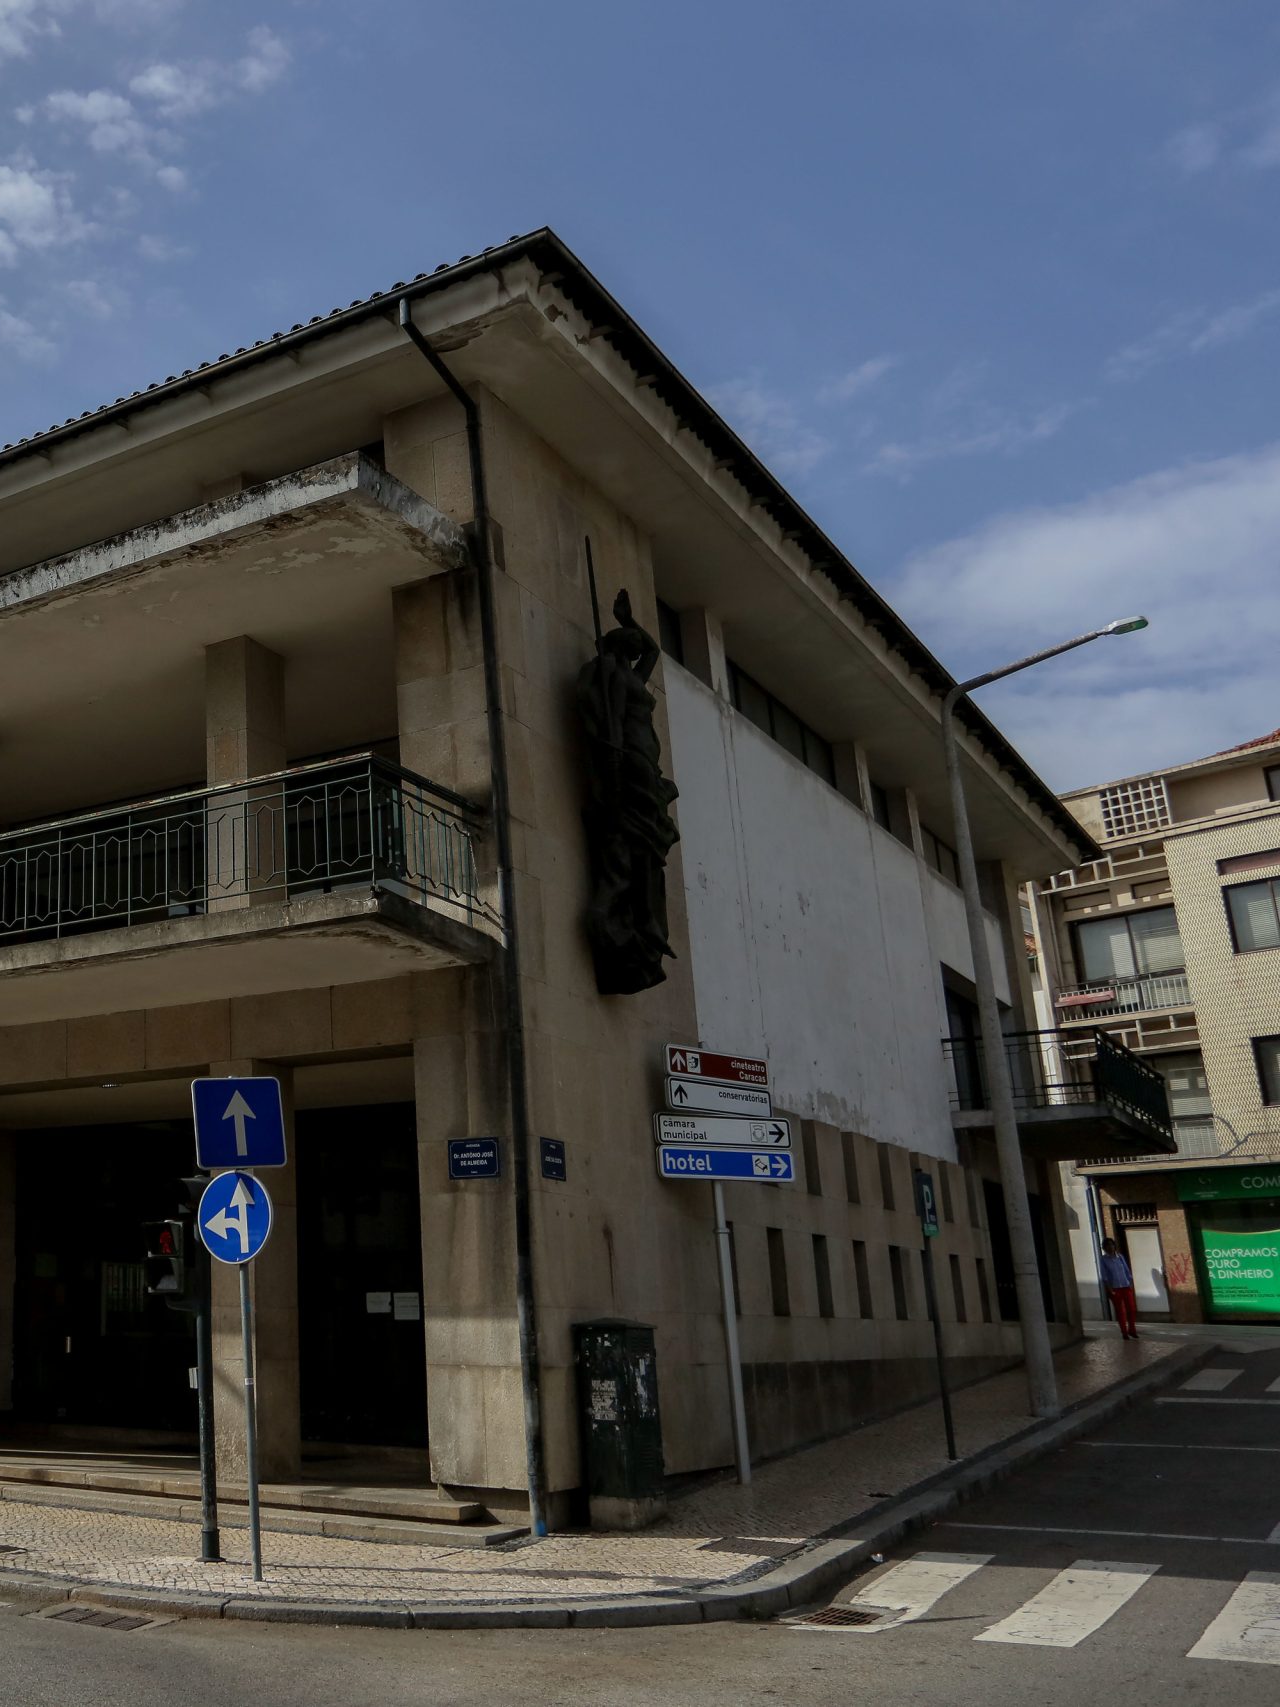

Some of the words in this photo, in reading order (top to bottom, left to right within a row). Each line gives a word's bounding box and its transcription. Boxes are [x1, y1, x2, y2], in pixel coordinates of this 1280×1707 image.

[731, 1060, 765, 1072] cineteatro
[739, 1071, 767, 1083] Caracas
[718, 1090, 768, 1104] conservatórias
[663, 1117, 696, 1129] câmara
[663, 1130, 708, 1141] municipal
[665, 1152, 713, 1171] hotel
[922, 1184, 932, 1223] P
[1204, 1247, 1279, 1259] COMPRAMOS
[1206, 1258, 1240, 1269] OURO
[1218, 1268, 1274, 1279] DINHEIRO
